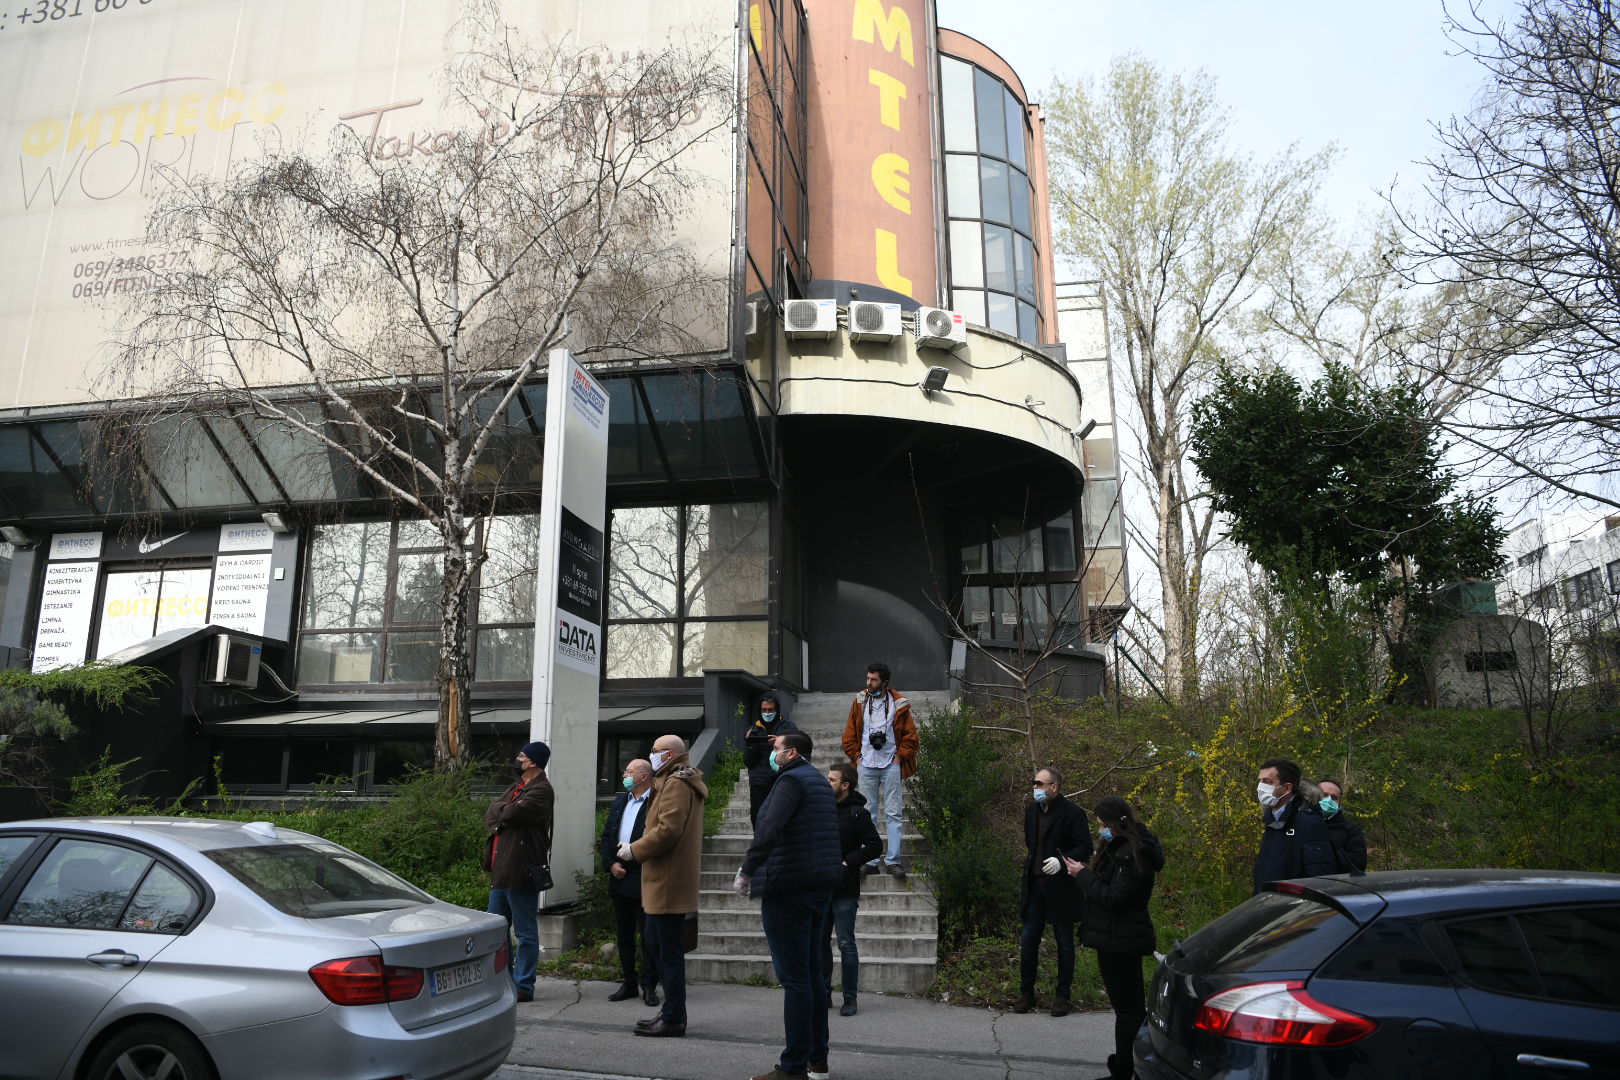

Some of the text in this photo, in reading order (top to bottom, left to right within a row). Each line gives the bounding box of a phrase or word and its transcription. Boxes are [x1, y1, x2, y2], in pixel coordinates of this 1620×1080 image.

[21, 82, 289, 158] ФИТНЕСС
[57, 538, 95, 548] ФИТНЕСС
[227, 528, 268, 538] ФИТНЕСС
[559, 619, 597, 656] DATA
[558, 643, 596, 665] INVESTMENT
